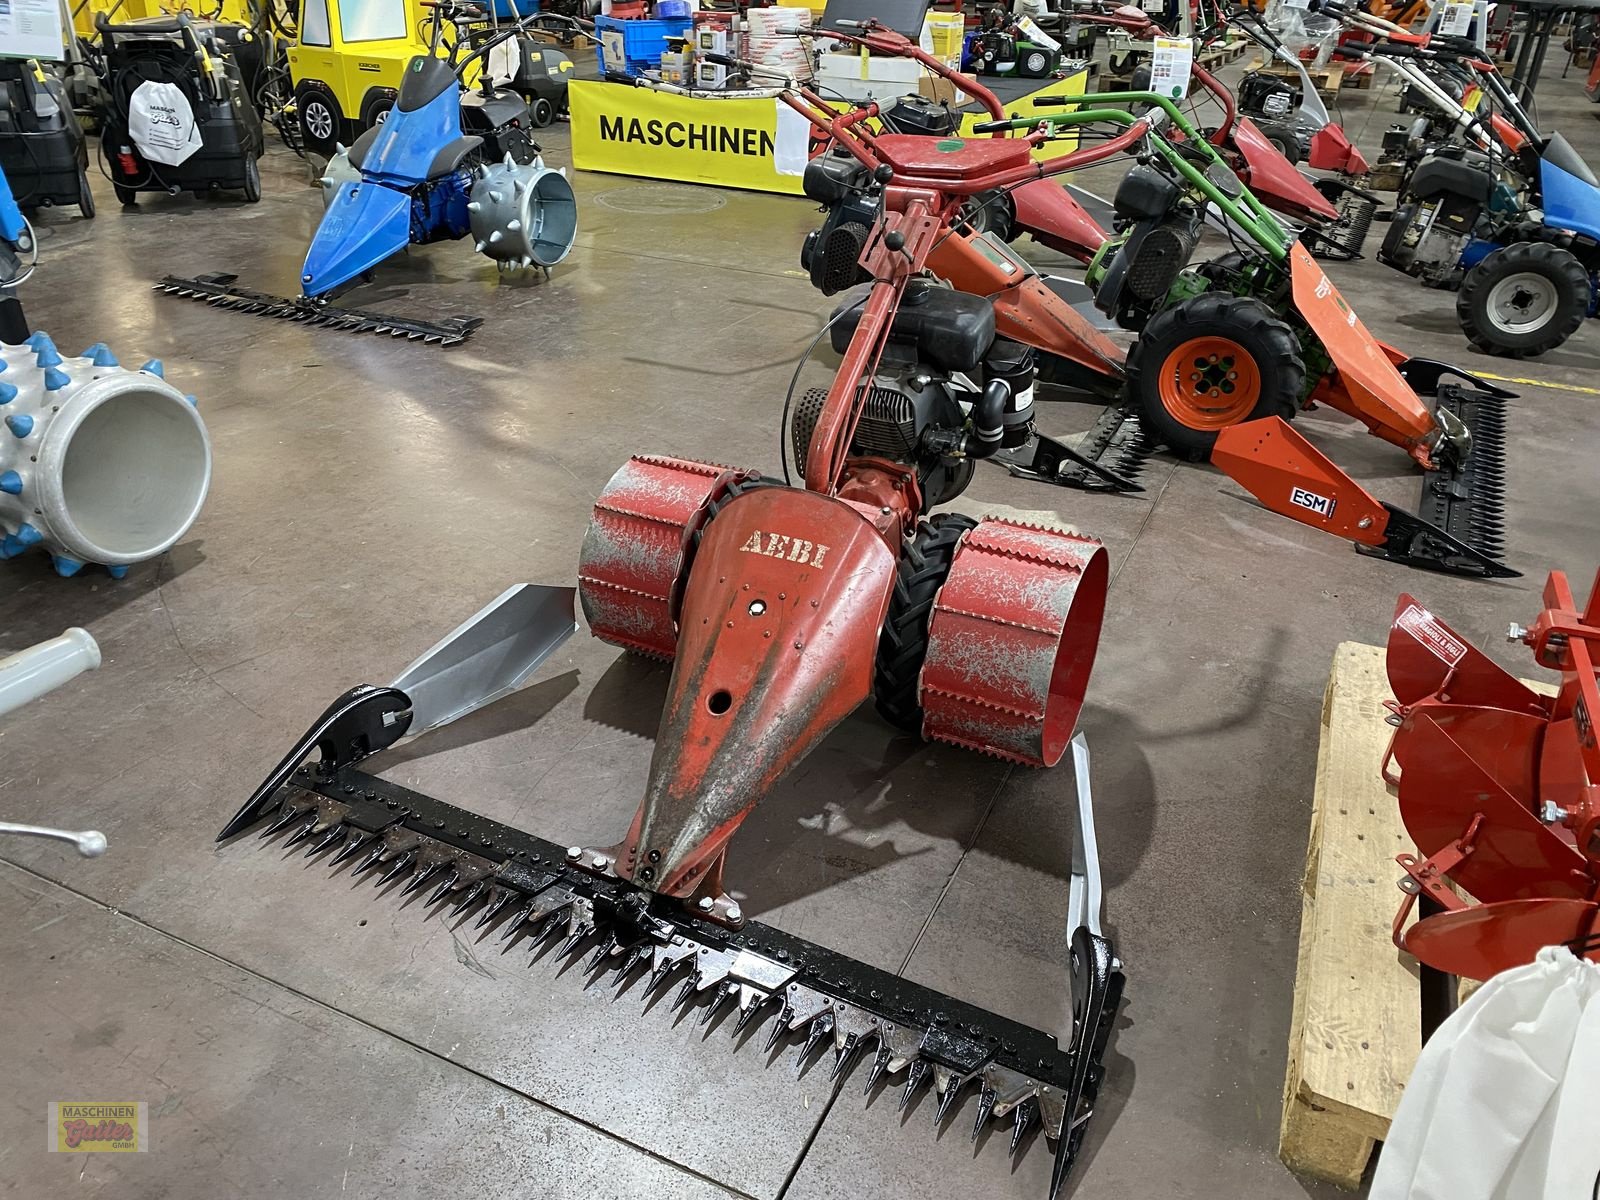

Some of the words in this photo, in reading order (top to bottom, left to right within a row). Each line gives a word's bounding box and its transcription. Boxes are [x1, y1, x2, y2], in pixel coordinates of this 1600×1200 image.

[599, 114, 777, 157] MASCHINEN
[1292, 489, 1327, 512] ESM
[739, 529, 831, 570] AEBI
[1445, 642, 1461, 657] FIGLI
